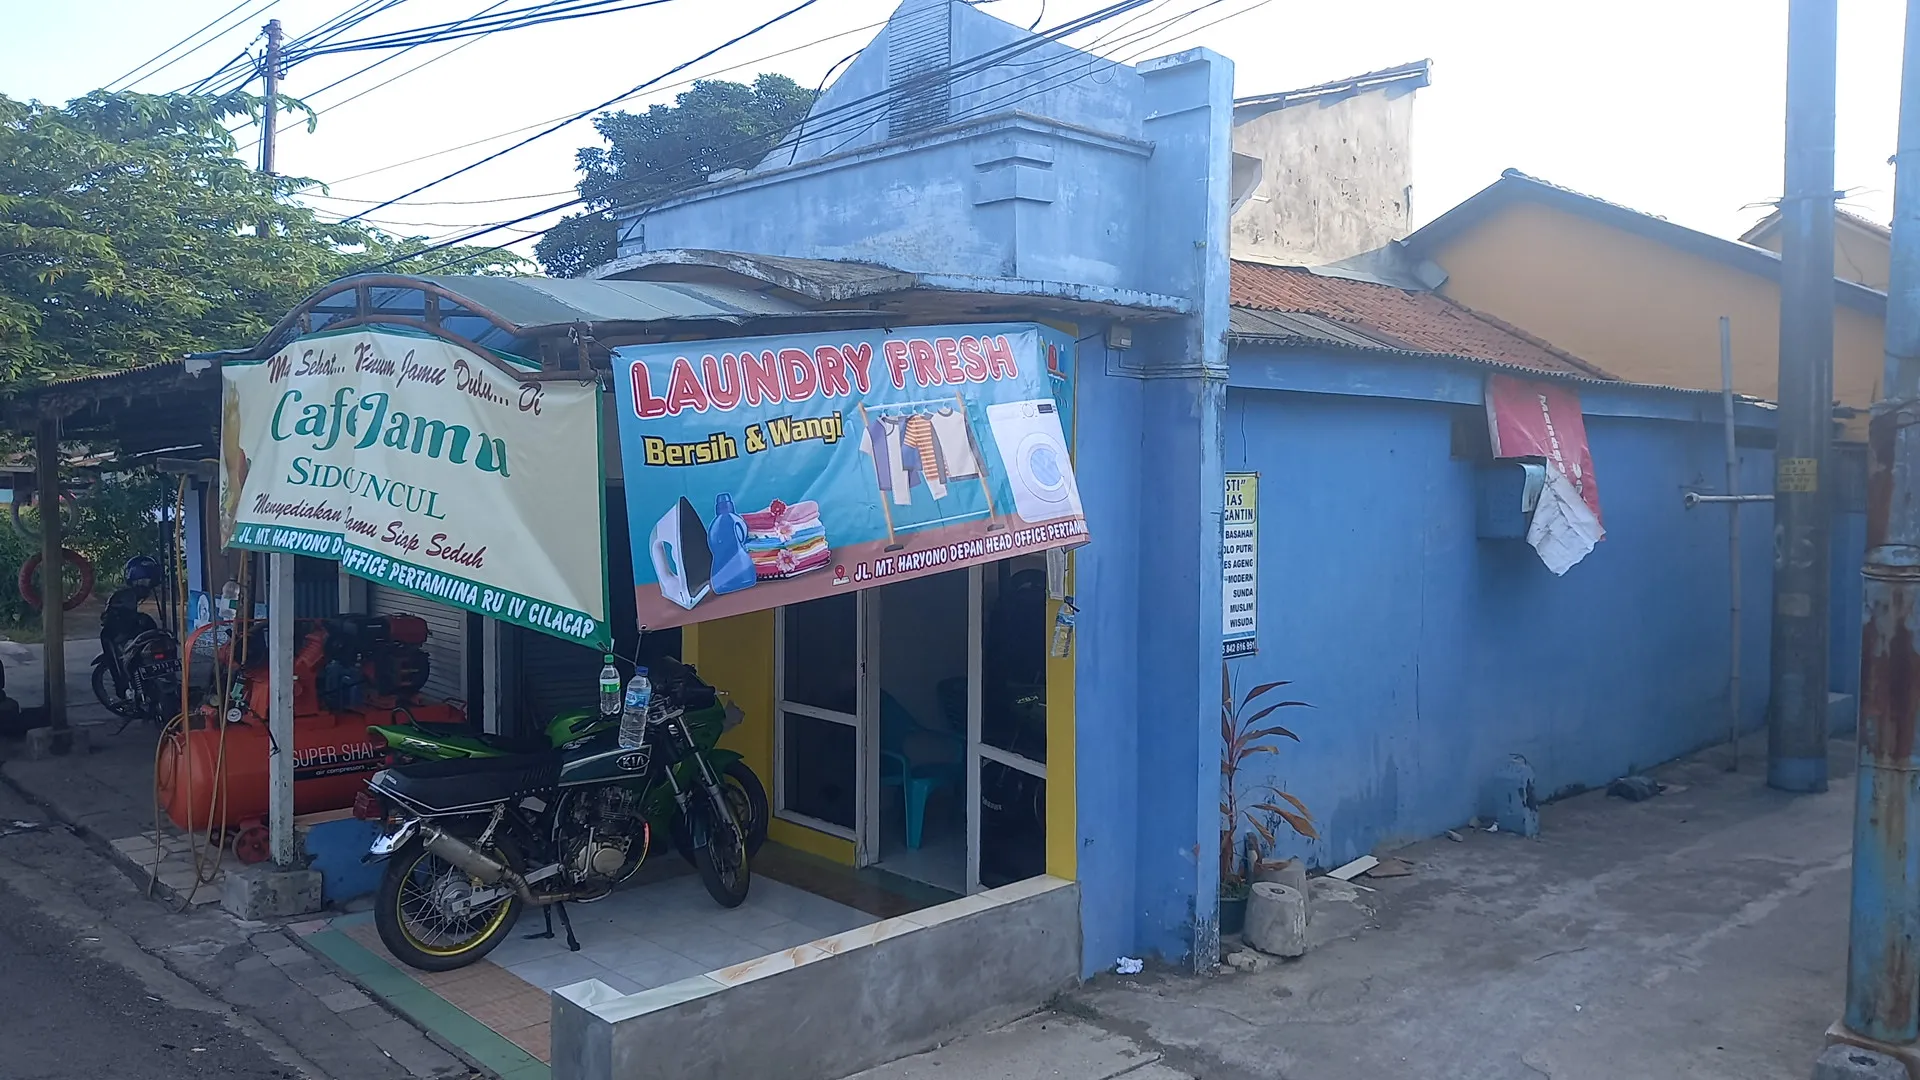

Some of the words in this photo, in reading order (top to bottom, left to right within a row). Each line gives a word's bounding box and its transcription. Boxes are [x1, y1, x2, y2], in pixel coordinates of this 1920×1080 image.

[630, 342, 874, 418] LAUNDRY
[882, 335, 1019, 390] FRESH
[519, 381, 545, 416] Di
[353, 392, 510, 477] Jamu
[641, 432, 739, 466] Bersih
[744, 423, 768, 454] &
[765, 411, 844, 447] Wangi
[252, 493, 342, 520] Menyediakan
[381, 520, 420, 555] Siap
[426, 533, 487, 569] Seduh
[1225, 529, 1254, 540] BASAHAN
[854, 563, 873, 582] JL.
[875, 557, 896, 579] MT.
[897, 544, 948, 573] HARYONO
[949, 538, 985, 562] DEPAN
[985, 531, 1014, 554] HEAD
[1014, 524, 1047, 548] OFFICE
[1232, 558, 1254, 569] AGENG
[1235, 544, 1254, 554] PUTRI
[238, 526, 252, 544] JL.
[254, 527, 270, 546] MT.
[271, 529, 331, 555] HARYONO
[342, 548, 387, 578] OFFICE
[388, 561, 478, 606] PERTAMIINA
[481, 589, 506, 613] RU
[507, 597, 526, 619] IV
[528, 603, 596, 640] CILACAP
[1232, 587, 1254, 599] SUNDA
[1229, 602, 1254, 613] MUSLIM
[1229, 617, 1254, 628] WISUDA
[292, 744, 338, 768] SUPER
